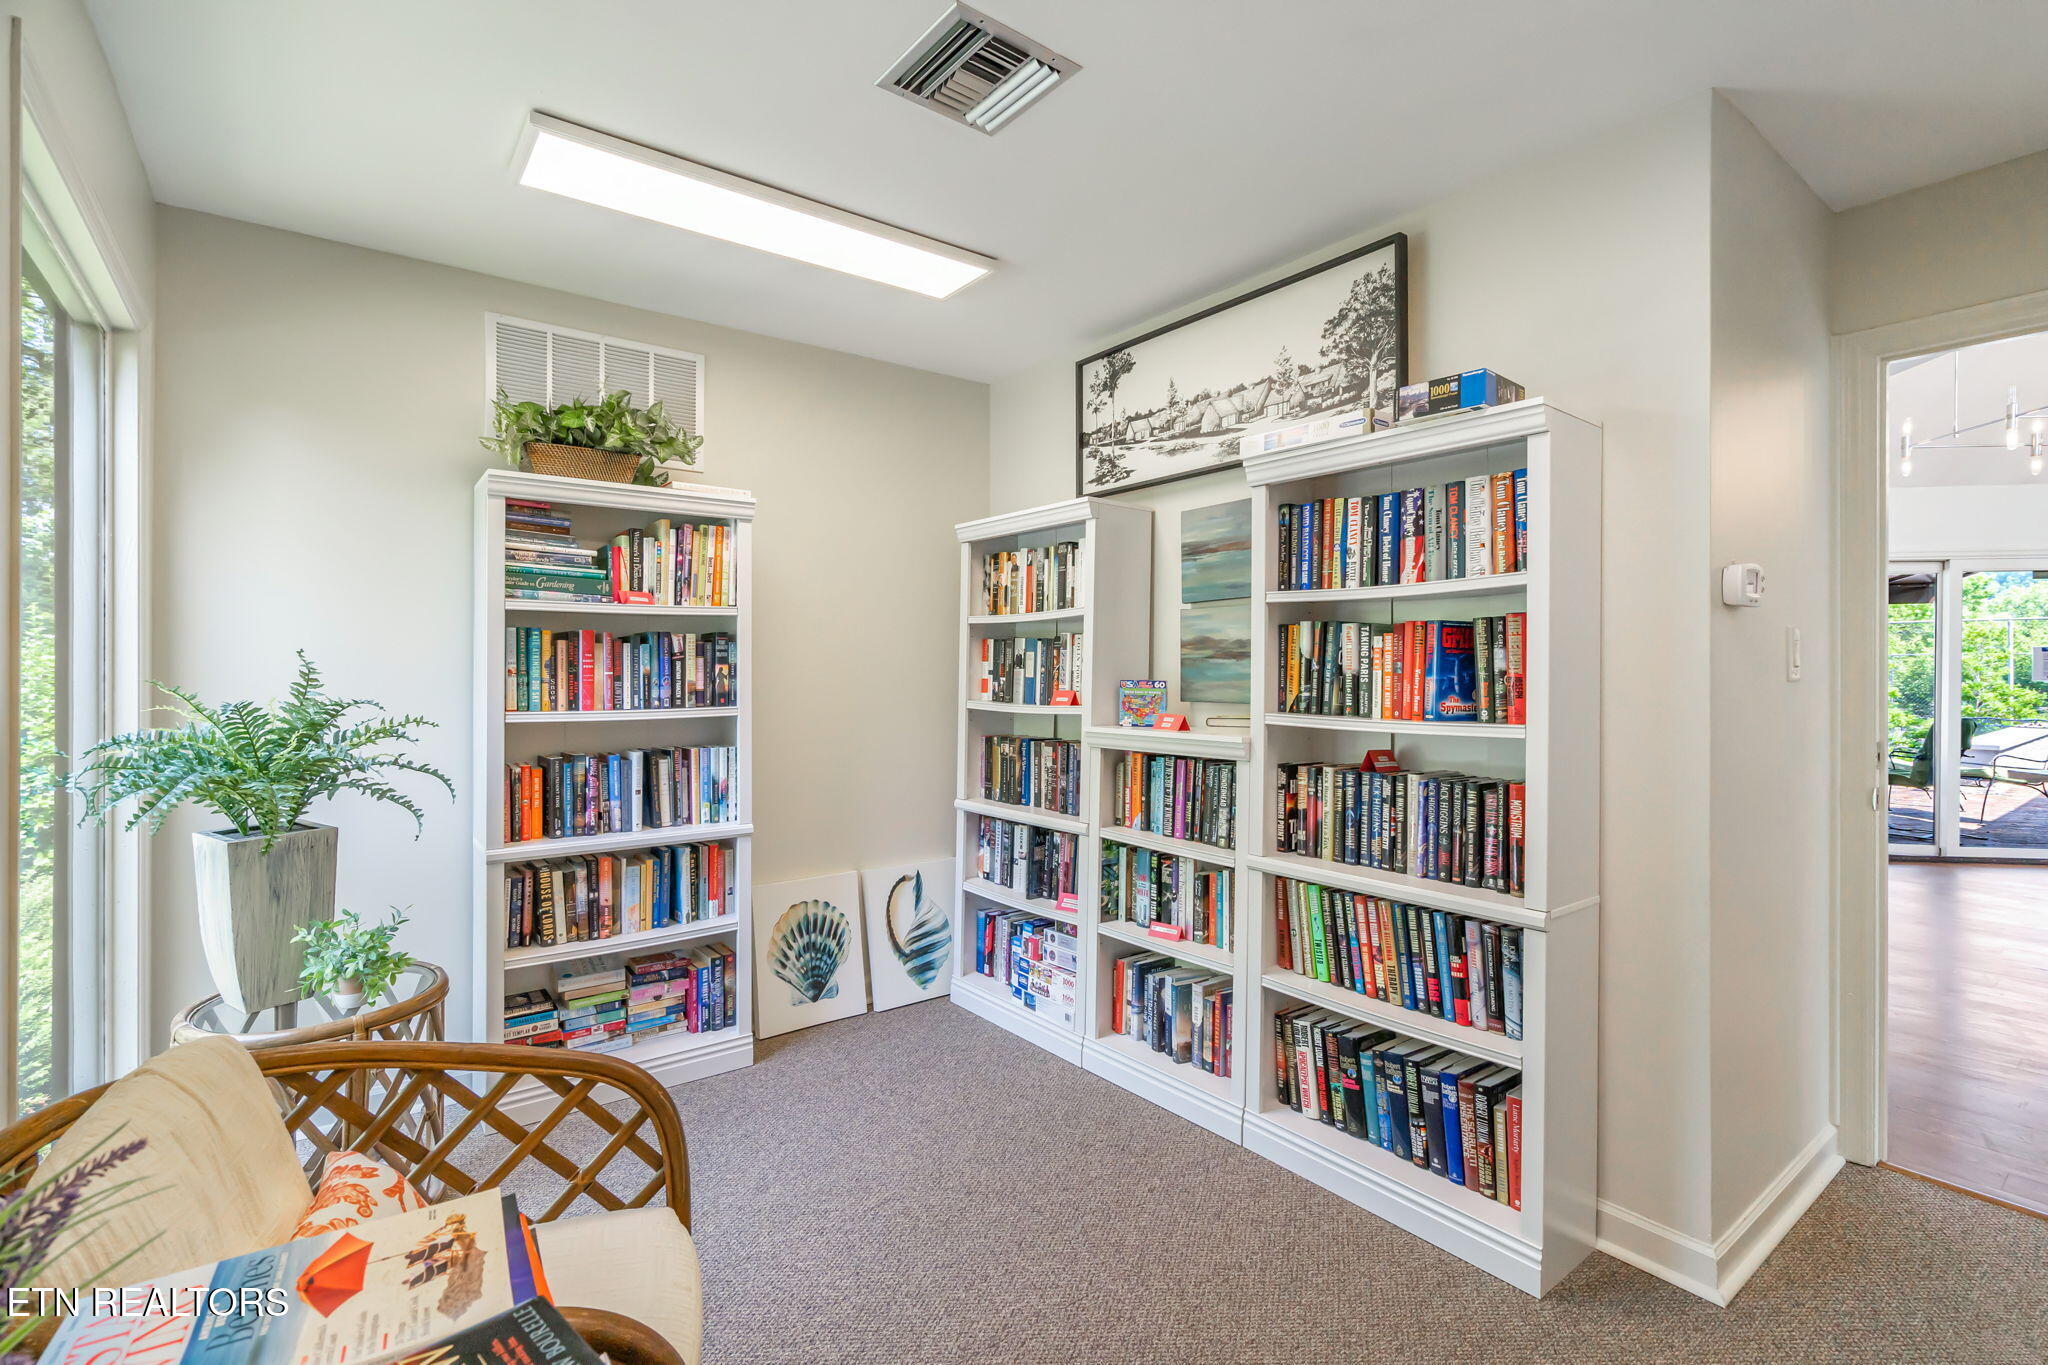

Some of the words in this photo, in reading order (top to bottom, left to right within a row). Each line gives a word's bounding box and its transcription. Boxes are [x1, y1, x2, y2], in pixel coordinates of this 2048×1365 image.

[1430, 384, 1450, 396] 1000
[1449, 486, 1458, 504] TOM
[1470, 480, 1486, 496] Tom
[1496, 478, 1510, 499] Tom
[1517, 477, 1528, 494] Tom
[1350, 501, 1359, 516] TOM
[1384, 495, 1392, 510] Tom
[1470, 498, 1486, 526] Clancy
[1516, 496, 1528, 522] Clancy
[1302, 506, 1310, 526] DAVID
[1381, 511, 1392, 534] Clancy
[1450, 506, 1459, 540] CLANCY
[1494, 502, 1510, 532] Clancy
[1302, 528, 1310, 560] BALDACCI
[1348, 520, 1358, 546] CLANCY
[1383, 536, 1392, 552] Debt
[1434, 526, 1442, 552] Clancy
[1498, 535, 1506, 548] Red
[1382, 561, 1391, 583] Honor
[1498, 550, 1506, 573] Rabbit
[536, 577, 575, 592] Gardening
[632, 563, 642, 592] Dictionary
[1360, 626, 1370, 657] TAKING
[1415, 624, 1424, 654] Griffin
[1426, 624, 1436, 653] Griffin
[532, 648, 541, 678] ATKINSON
[1479, 644, 1488, 668] Allies
[1360, 658, 1369, 683] PARIS
[1414, 668, 1422, 688] Victory
[1514, 676, 1522, 698] JOSEPH
[1220, 768, 1228, 807] THUNDERHEAD
[1372, 778, 1382, 796] JACK
[1396, 783, 1404, 796] JACK
[1428, 782, 1436, 797] JACK
[1440, 782, 1450, 800] JACK
[1454, 786, 1462, 799] JACK
[1468, 789, 1477, 804] JACK
[1164, 806, 1172, 836] KINGDOM
[1372, 798, 1381, 832] HIGGINS
[1382, 802, 1390, 821] ANGEL
[1396, 798, 1404, 822] HIGGINS
[1440, 802, 1450, 834] HIGGINS
[1468, 806, 1477, 832] HIGGINS
[1510, 800, 1522, 838] MONSTRUM
[540, 872, 552, 900] HOUSE
[542, 901, 552, 911] OF
[542, 914, 554, 940] LORDS
[1422, 912, 1432, 941] JONATHAN
[1384, 932, 1393, 961] KELLERMAN
[1425, 942, 1436, 974] KELLERMAN
[1374, 964, 1385, 989] GONE
[1387, 964, 1398, 996] THERAPY
[1414, 966, 1425, 1000] OBSESSION
[1427, 978, 1440, 1002] RAGE
[512, 1028, 531, 1037] TEMPLAR
[1284, 1024, 1292, 1044] ROBERT
[1294, 1022, 1302, 1048] LUDLUM
[1301, 1024, 1310, 1048] ROBERT
[1314, 1027, 1322, 1047] ROBERT
[1315, 1047, 1324, 1067] LUDLUM
[1326, 1036, 1338, 1056] ROBERT
[1298, 1051, 1308, 1086] APOCALYPSE
[1329, 1058, 1341, 1084] LUDLUM
[1406, 1066, 1417, 1090] ROBERT
[1302, 1087, 1311, 1108] WATCH
[1335, 1092, 1344, 1121] TRISTAN
[1408, 1091, 1420, 1114] LUDLUM
[1475, 1094, 1487, 1118] ROBERT
[1512, 1104, 1520, 1122] Liane
[1460, 1100, 1470, 1159] INHERITANCE
[1476, 1118, 1489, 1144] LUDLUM
[1512, 1123, 1520, 1154] Moriarty
[1416, 1134, 1424, 1158] JANSON
[1468, 1121, 1476, 1167] SCARLATTI
[512, 1305, 566, 1360] BOURELLE
